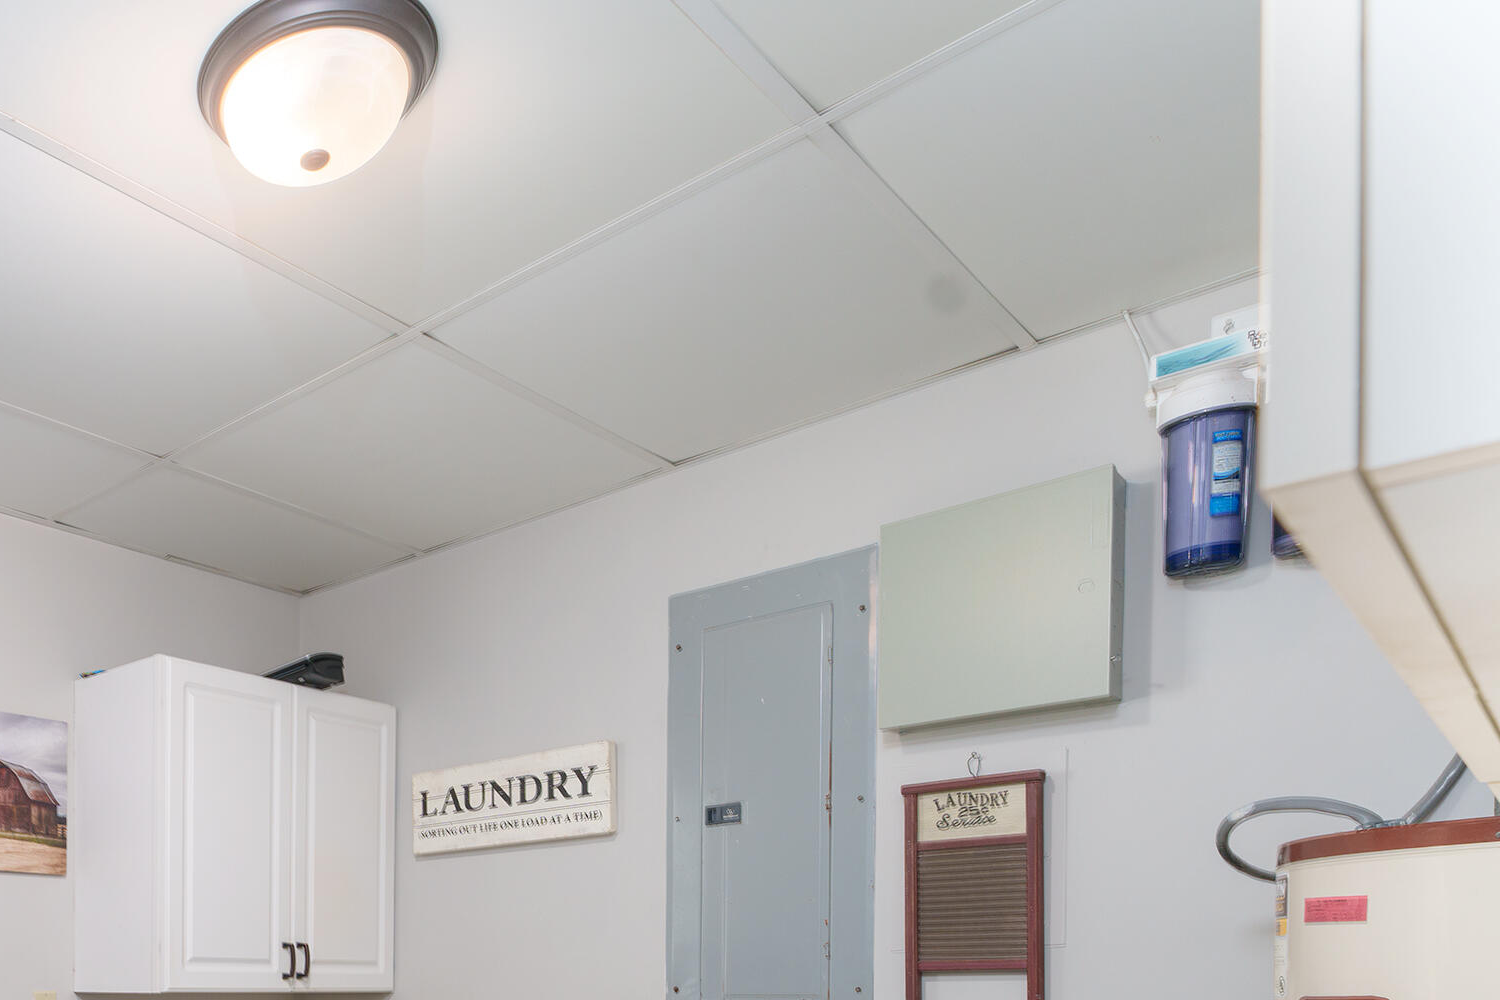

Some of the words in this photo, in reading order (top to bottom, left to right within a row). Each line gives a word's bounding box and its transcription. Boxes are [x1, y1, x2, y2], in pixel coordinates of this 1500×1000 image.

[419, 765, 598, 818] LAUNDRY
[933, 790, 1009, 812] LAUNDRY
[936, 813, 997, 829] Service
[958, 806, 990, 818] 25¢
[460, 823, 477, 834] OUT
[480, 821, 499, 833] LIFE
[500, 819, 520, 830] ONE
[521, 816, 548, 828] LOAD
[549, 814, 562, 825] AT
[564, 813, 572, 824] A
